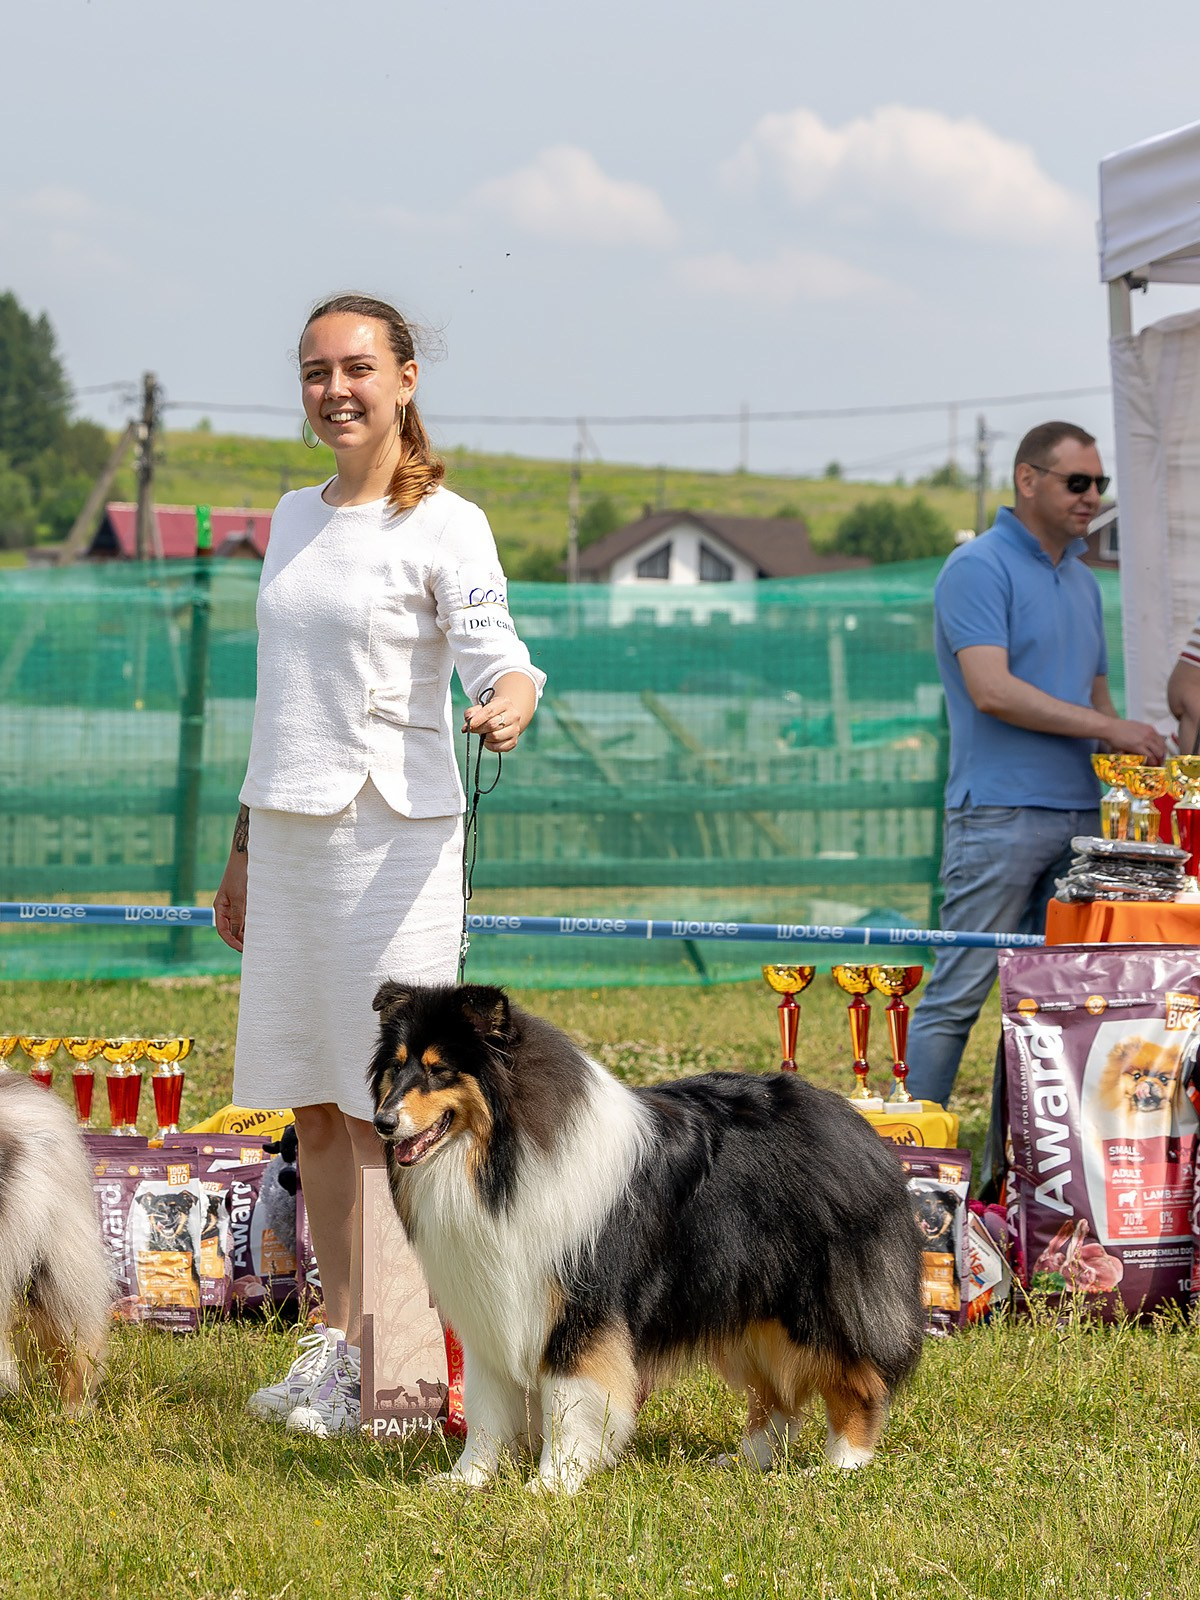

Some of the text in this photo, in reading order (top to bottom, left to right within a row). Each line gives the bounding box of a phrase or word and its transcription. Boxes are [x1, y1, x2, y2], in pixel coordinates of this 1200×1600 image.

[1016, 1020, 1074, 1217] Award
[1021, 1104, 1030, 1125] FOR
[1023, 1128, 1034, 1173] QUALITY
[169, 1165, 188, 1174] 100%
[1112, 1169, 1142, 1178] ADULT
[170, 1174, 188, 1184] BIO
[1143, 1190, 1172, 1200] LAMB
